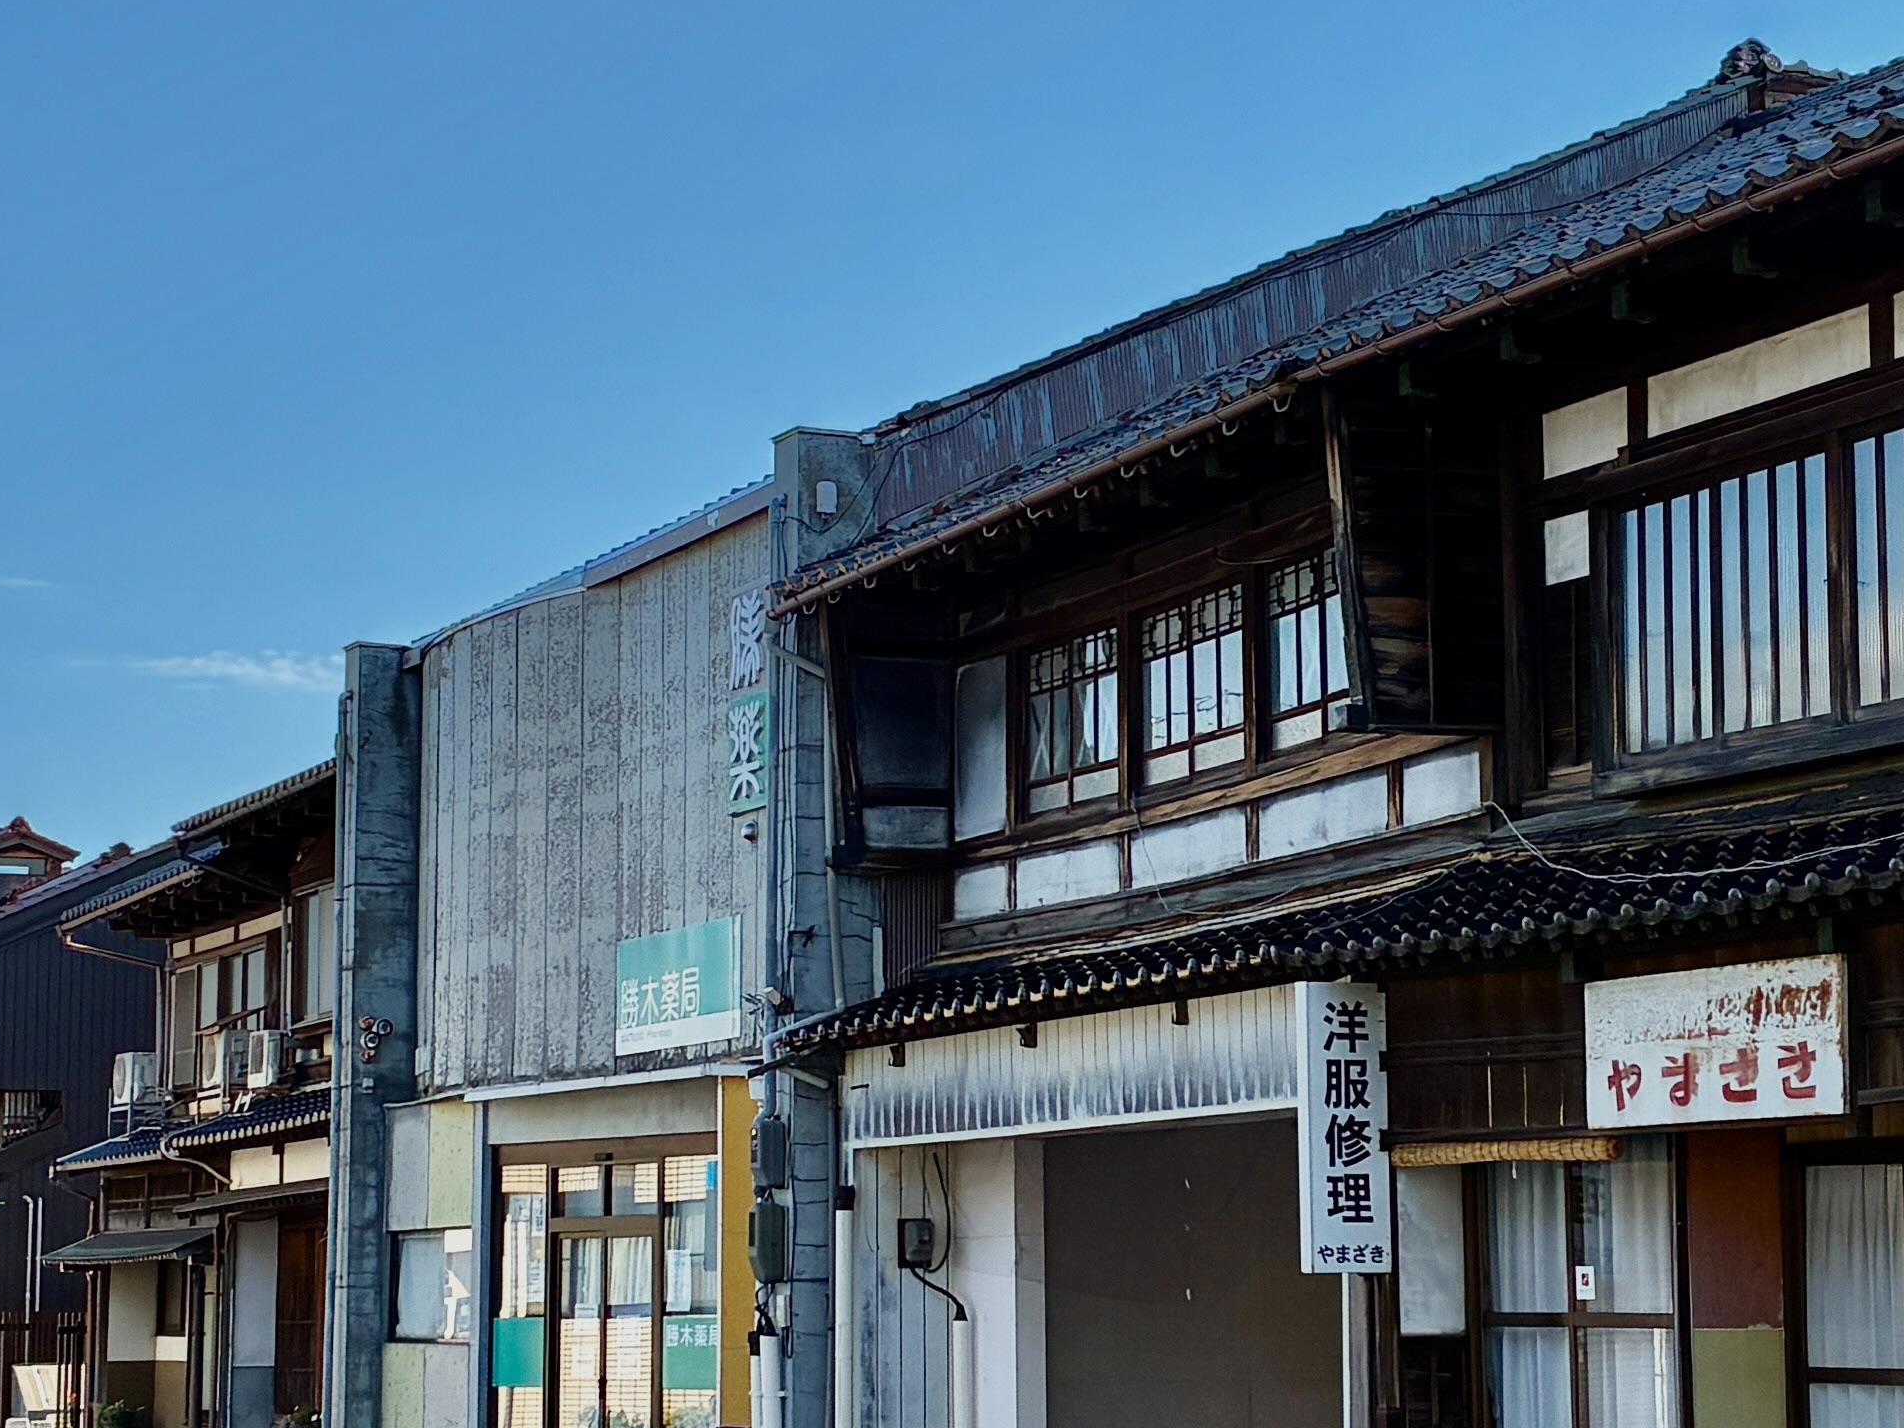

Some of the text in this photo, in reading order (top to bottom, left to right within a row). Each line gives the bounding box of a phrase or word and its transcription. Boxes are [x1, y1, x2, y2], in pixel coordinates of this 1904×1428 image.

[621, 966, 700, 1029] 勝木薬局
[1323, 1000, 1374, 1223] 洋服修理
[1317, 1244, 1384, 1265] やまざき
